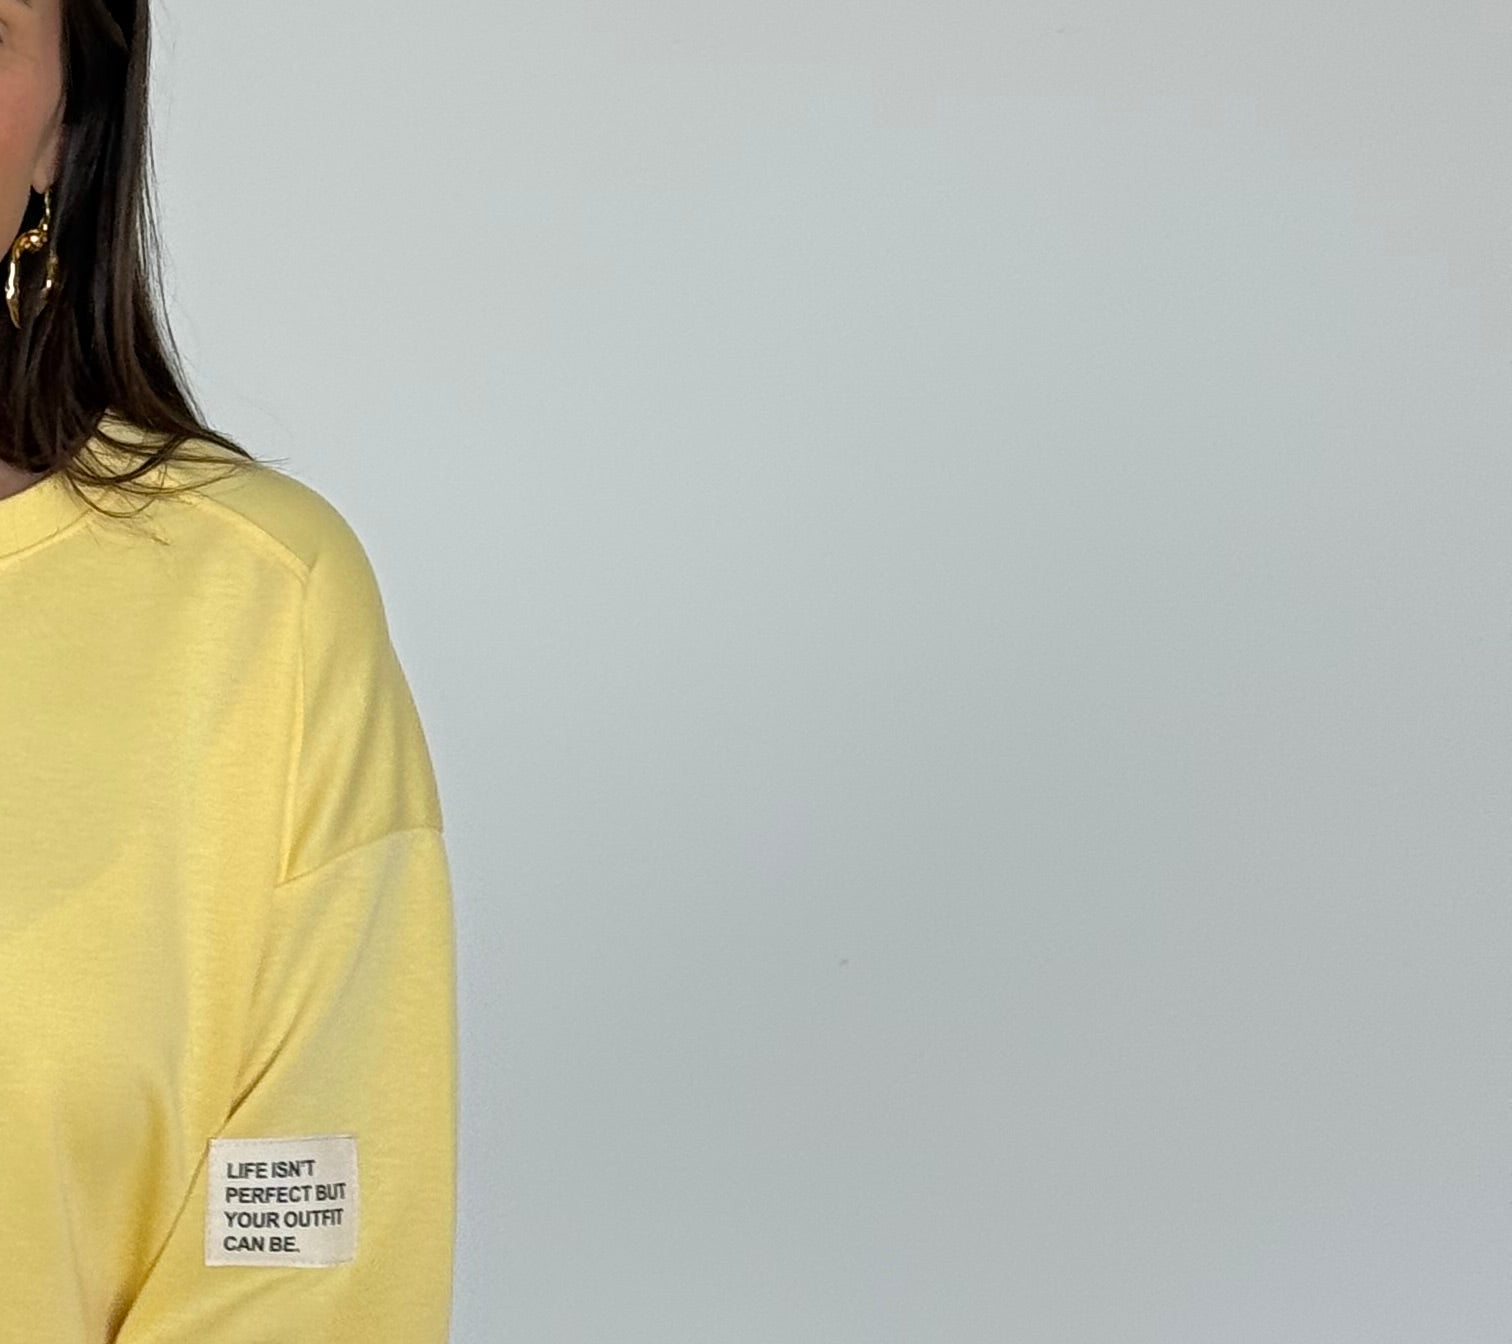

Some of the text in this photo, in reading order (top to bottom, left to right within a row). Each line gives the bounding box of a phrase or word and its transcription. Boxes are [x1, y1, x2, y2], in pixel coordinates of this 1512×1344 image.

[226, 1159, 316, 1179] LIFE ISN'T
[225, 1182, 347, 1204] PERFECT BUT
[224, 1208, 344, 1228] YOUR OUTFIT
[223, 1235, 301, 1253] CAN BE.
